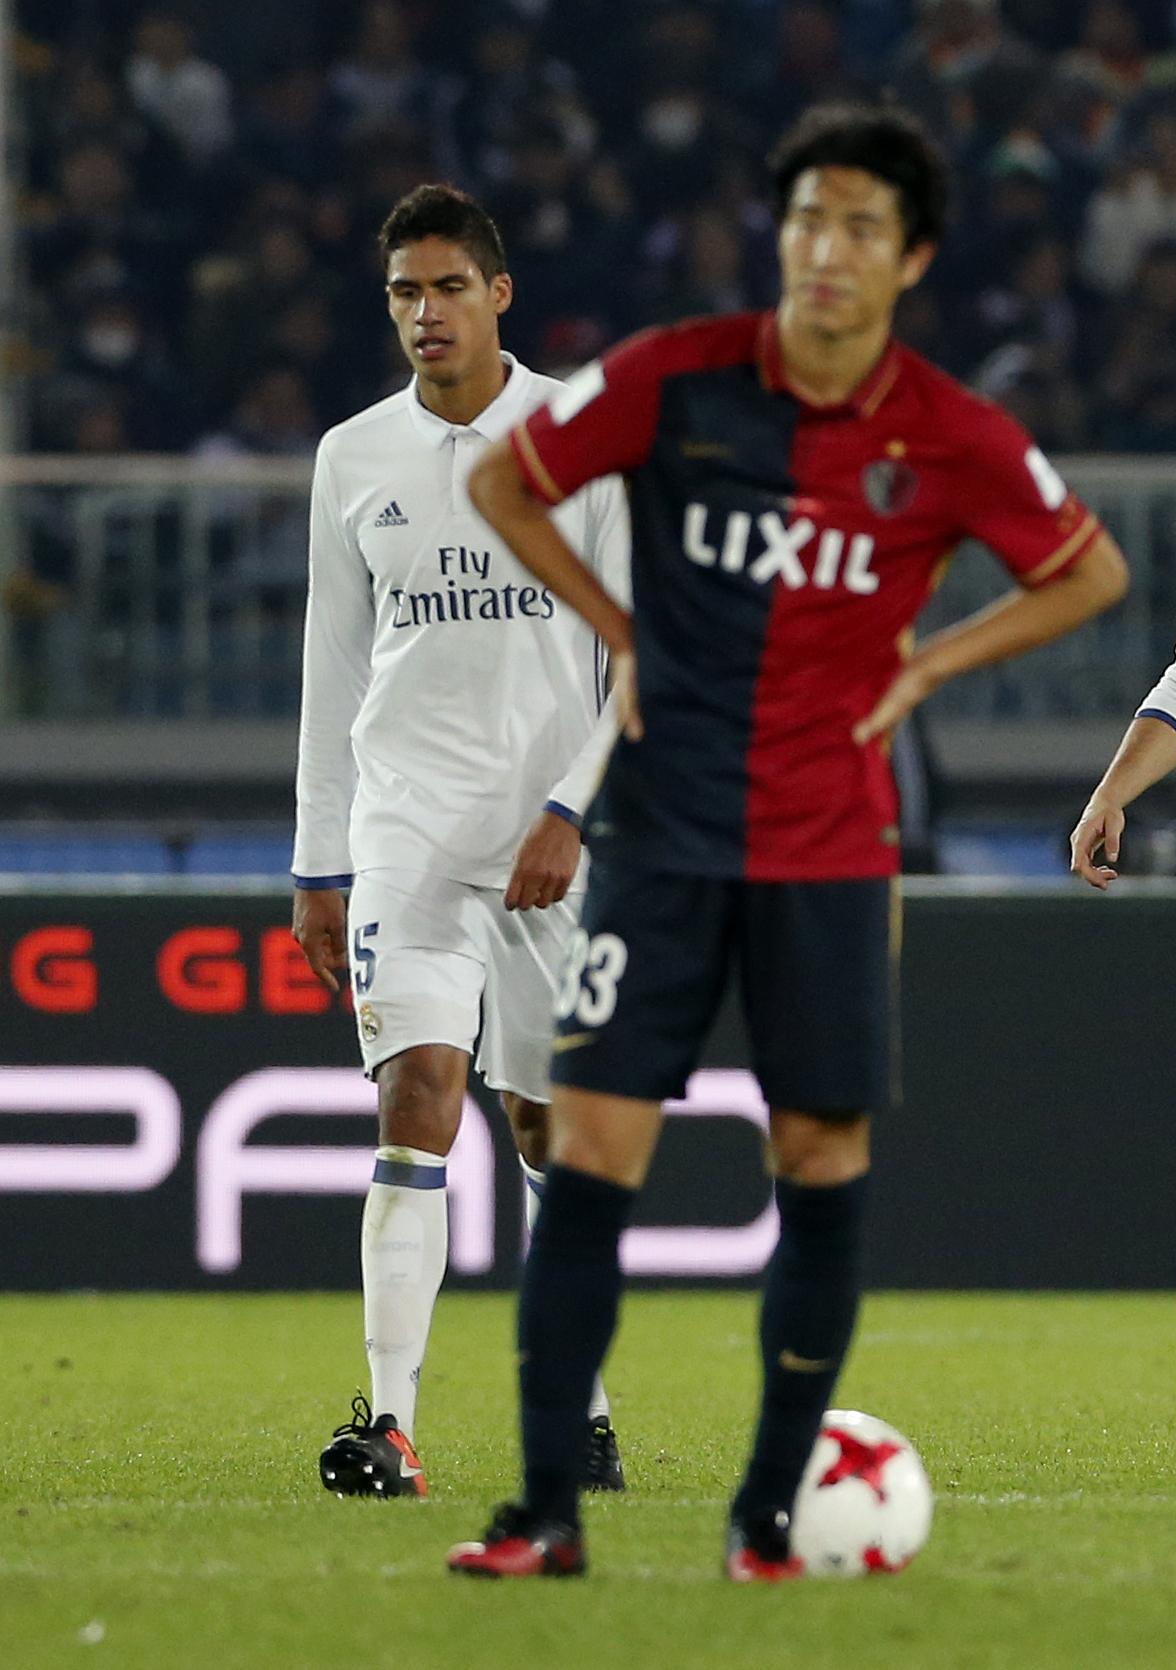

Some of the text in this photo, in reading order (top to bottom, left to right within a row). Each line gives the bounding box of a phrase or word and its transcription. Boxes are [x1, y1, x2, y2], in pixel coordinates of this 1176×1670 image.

[438, 547, 491, 579] Fly
[683, 502, 879, 594] LIXIL
[390, 580, 555, 628] Emirates
[0, 925, 98, 1014] G
[354, 922, 379, 994] 5
